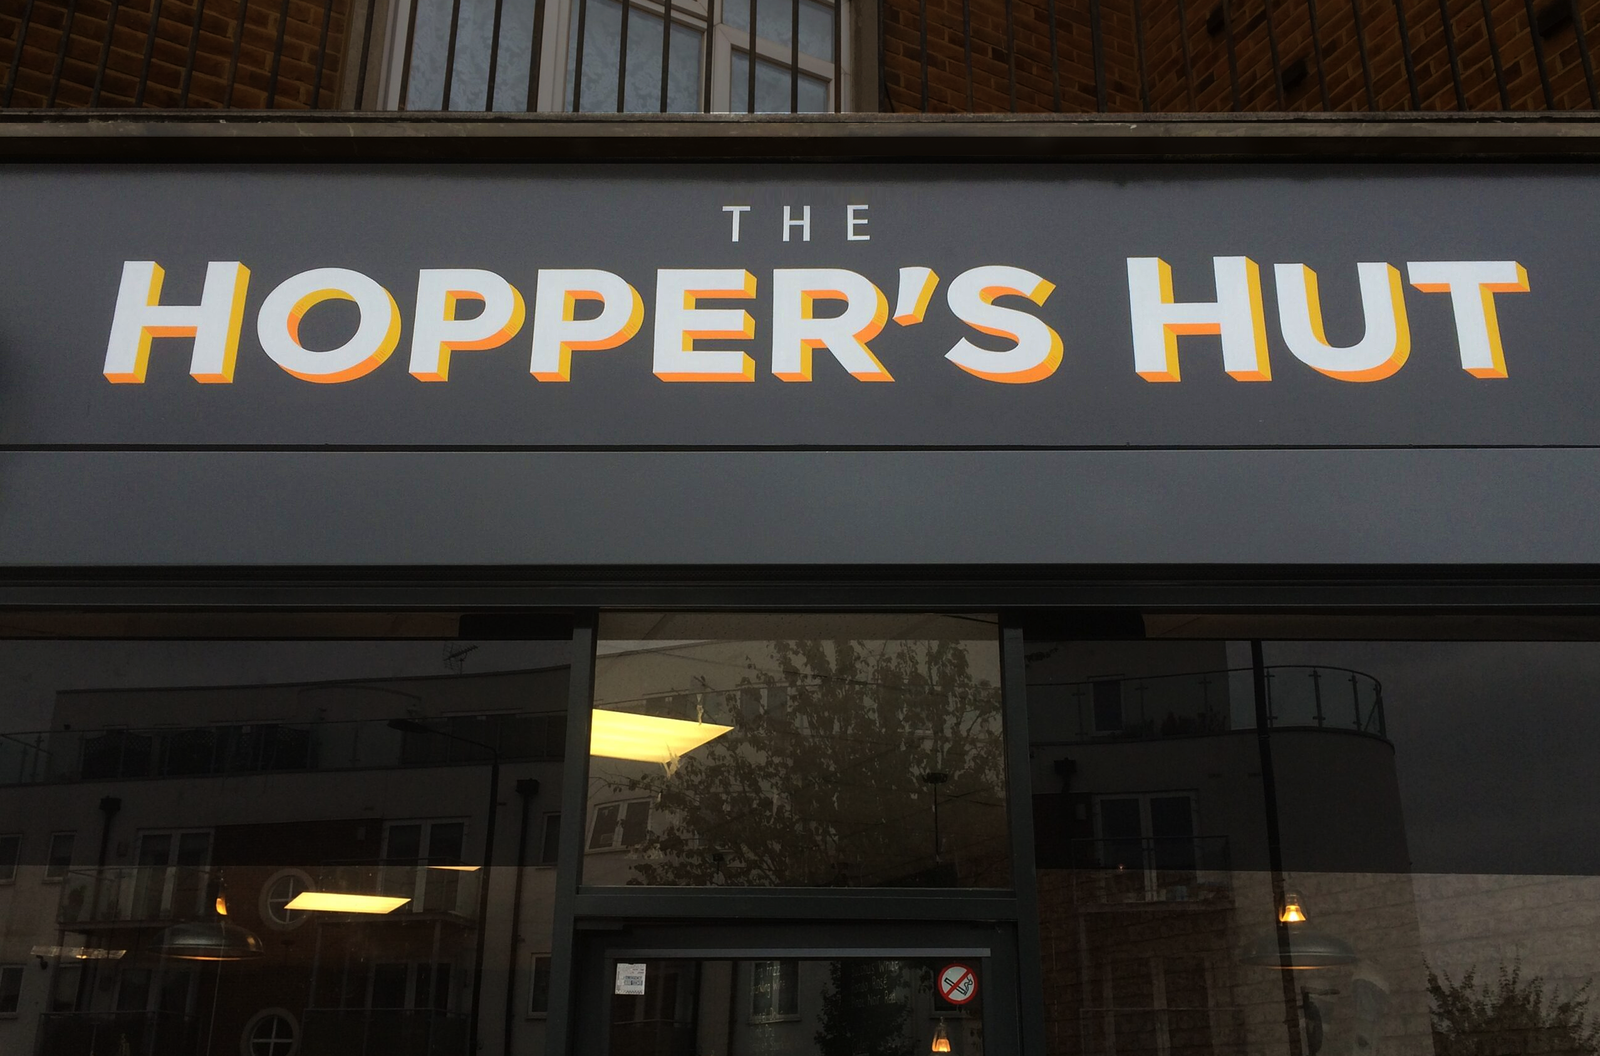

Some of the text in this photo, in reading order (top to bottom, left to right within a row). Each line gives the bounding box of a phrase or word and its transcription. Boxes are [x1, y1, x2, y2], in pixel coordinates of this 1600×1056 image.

[722, 205, 871, 242] THE
[103, 256, 1531, 384] HOPPER'S HUT
